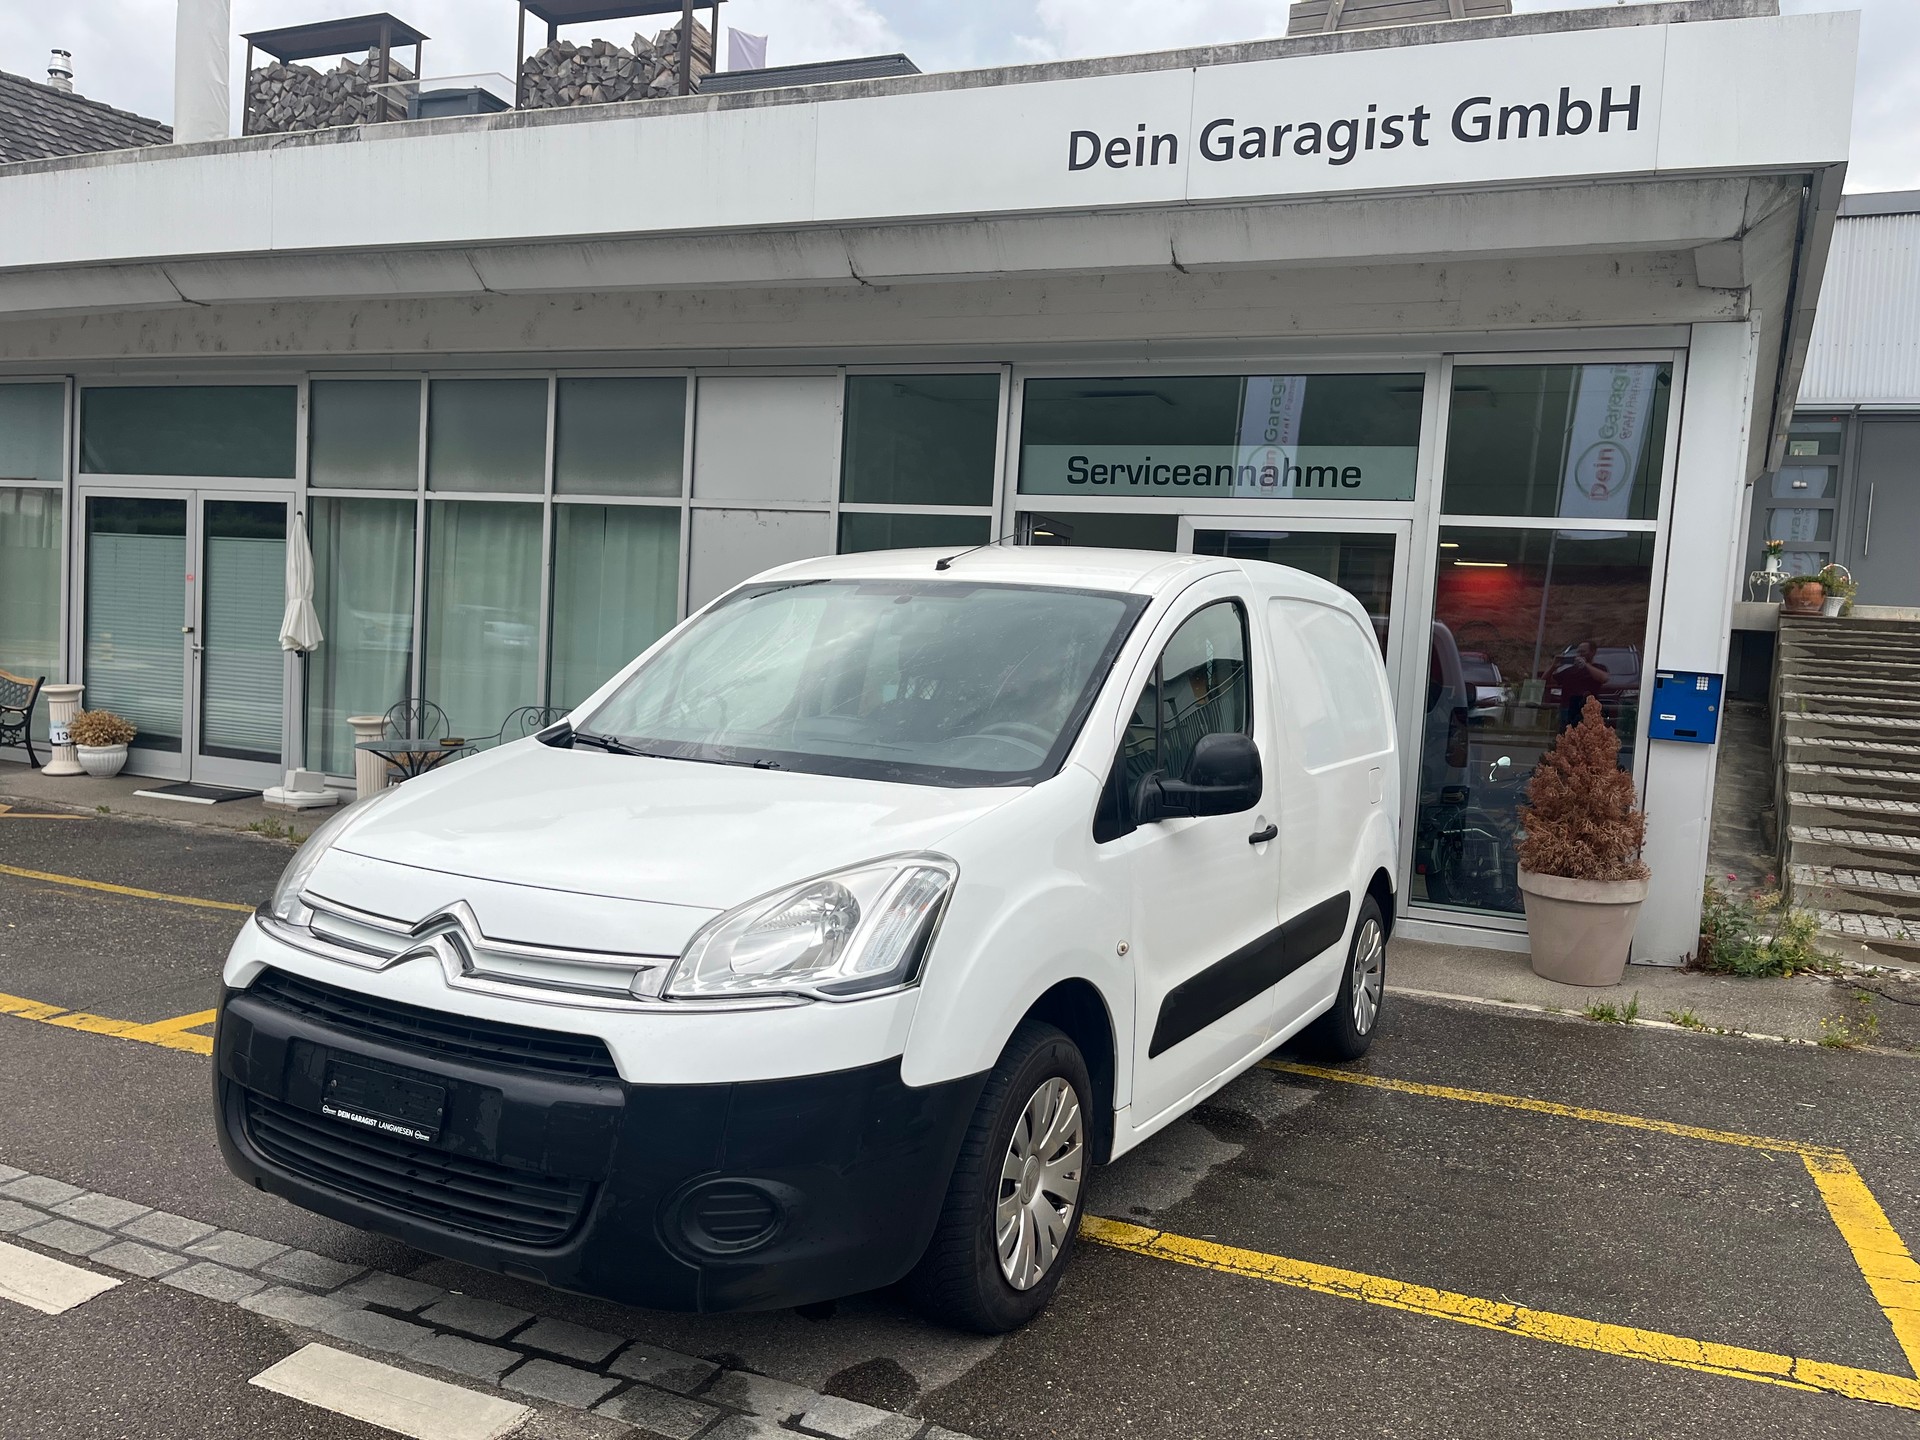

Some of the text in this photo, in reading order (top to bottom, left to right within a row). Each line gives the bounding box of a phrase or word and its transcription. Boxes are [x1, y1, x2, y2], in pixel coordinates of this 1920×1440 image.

[1068, 84, 1641, 172] Dein Garagist GmbH
[1590, 364, 1631, 501] Dein Garagi
[1066, 455, 1362, 489] Serviceannahme
[338, 1109, 350, 1119] DEIN
[351, 1113, 377, 1126] GARAGIST
[379, 1121, 413, 1136] LANGWIESEN
